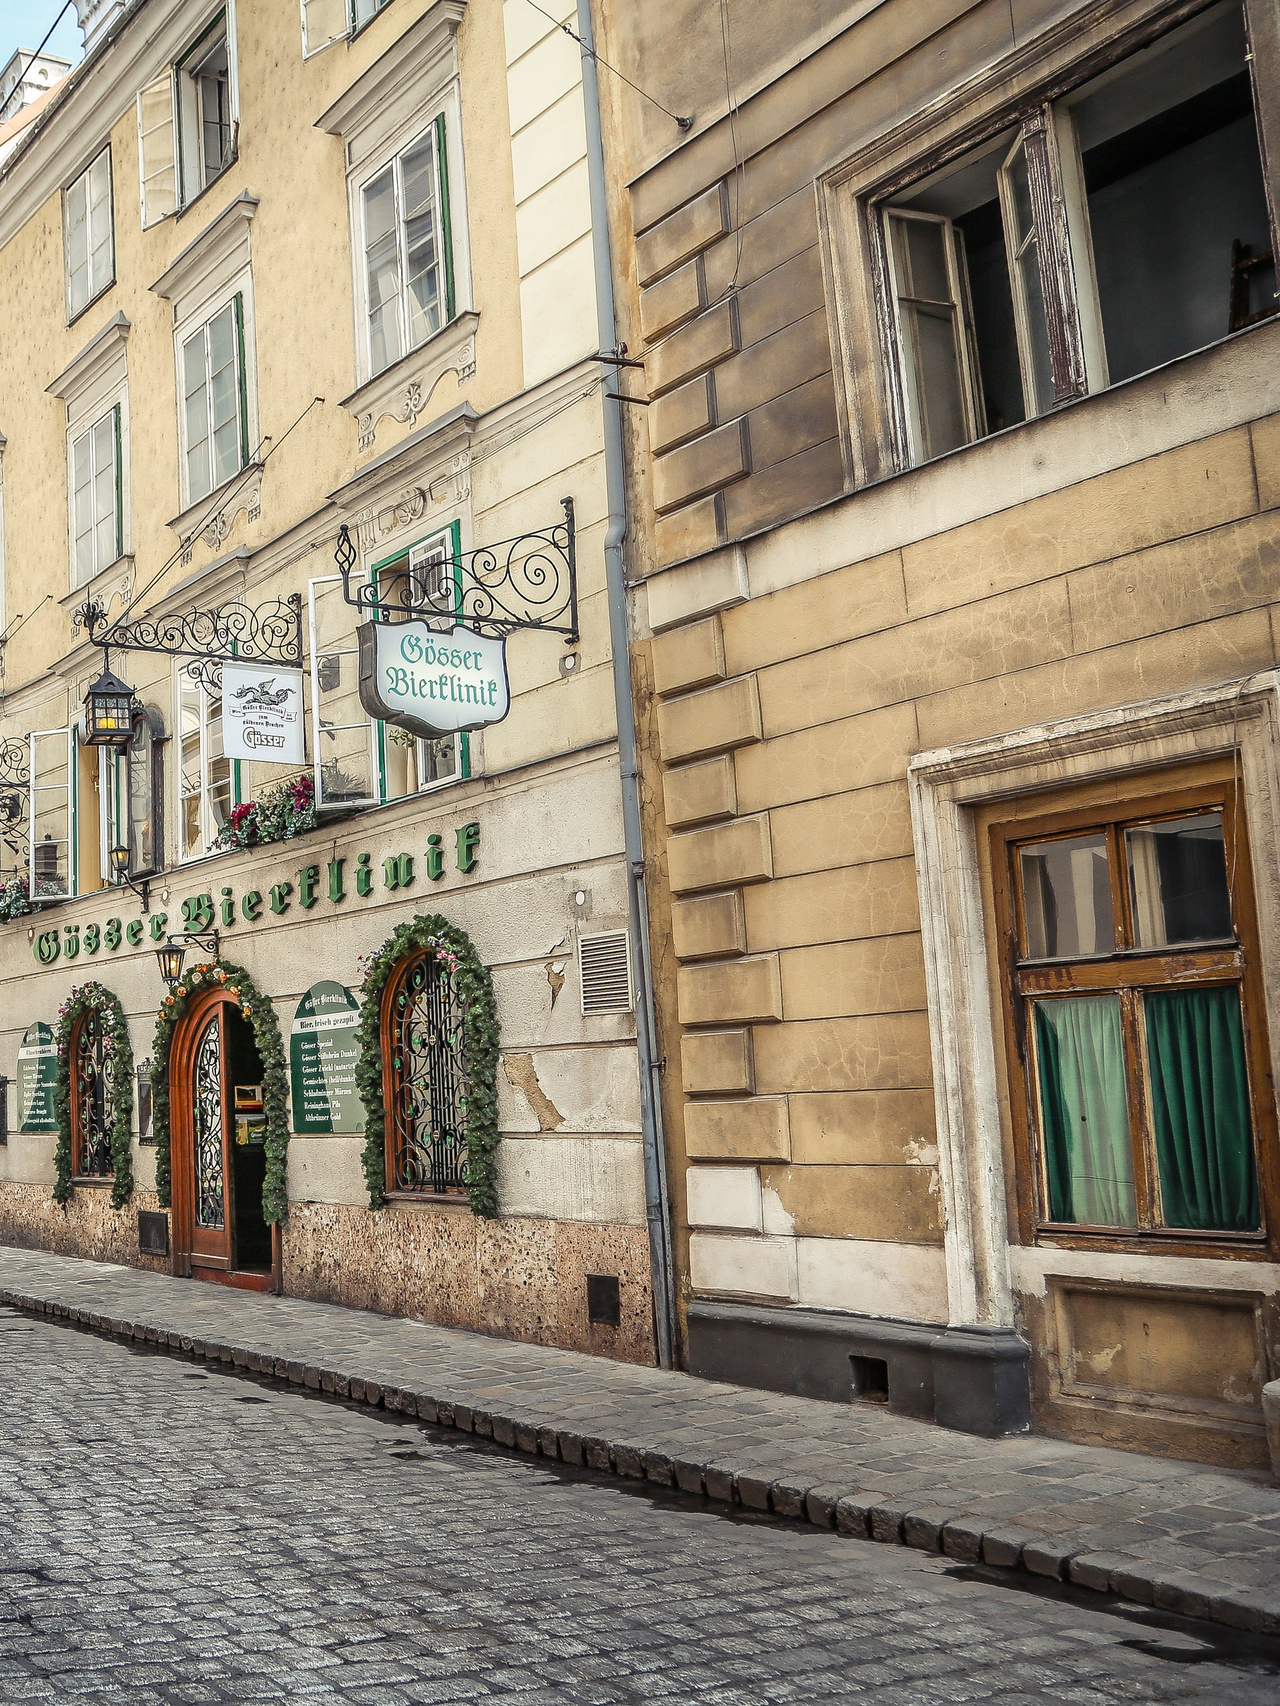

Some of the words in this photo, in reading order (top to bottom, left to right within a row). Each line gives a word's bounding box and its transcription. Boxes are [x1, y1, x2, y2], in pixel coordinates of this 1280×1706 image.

[400, 634, 483, 671] Gösser
[386, 666, 498, 707] Bierklinik
[242, 726, 285, 749] Gösser
[33, 912, 169, 965] Gösser
[180, 821, 481, 933] Bierklinik
[320, 993, 348, 1007] Bierklinik
[314, 1018, 332, 1028] frisch
[332, 1014, 354, 1026] gezapft
[300, 1041, 316, 1050] Gösser
[301, 1053, 317, 1063] Gösser
[340, 1048, 358, 1058] Dunkel
[302, 1065, 318, 1074] Gösser
[318, 1063, 334, 1073] Zwickl
[330, 1112, 342, 1121] Gold
